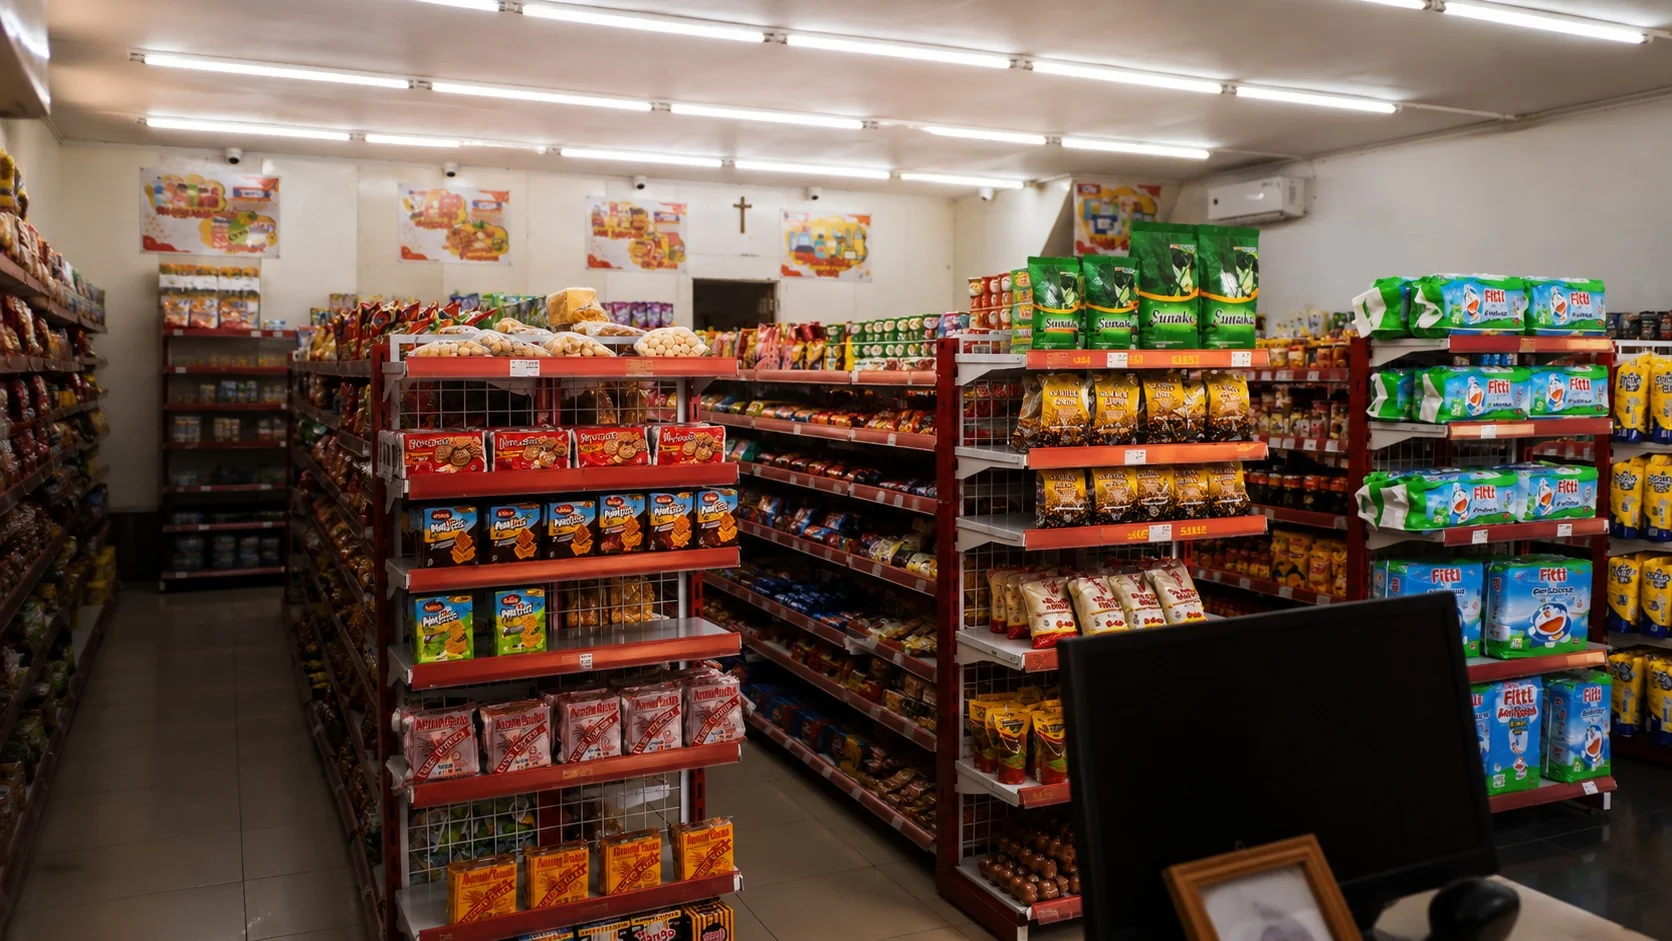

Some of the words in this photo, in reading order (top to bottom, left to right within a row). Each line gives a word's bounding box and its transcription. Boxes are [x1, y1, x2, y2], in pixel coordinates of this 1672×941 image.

[1488, 379, 1510, 394] Fitti
[1569, 377, 1591, 392] Fitti
[1432, 568, 1462, 584] Fitti
[1539, 567, 1568, 583] Fitti
